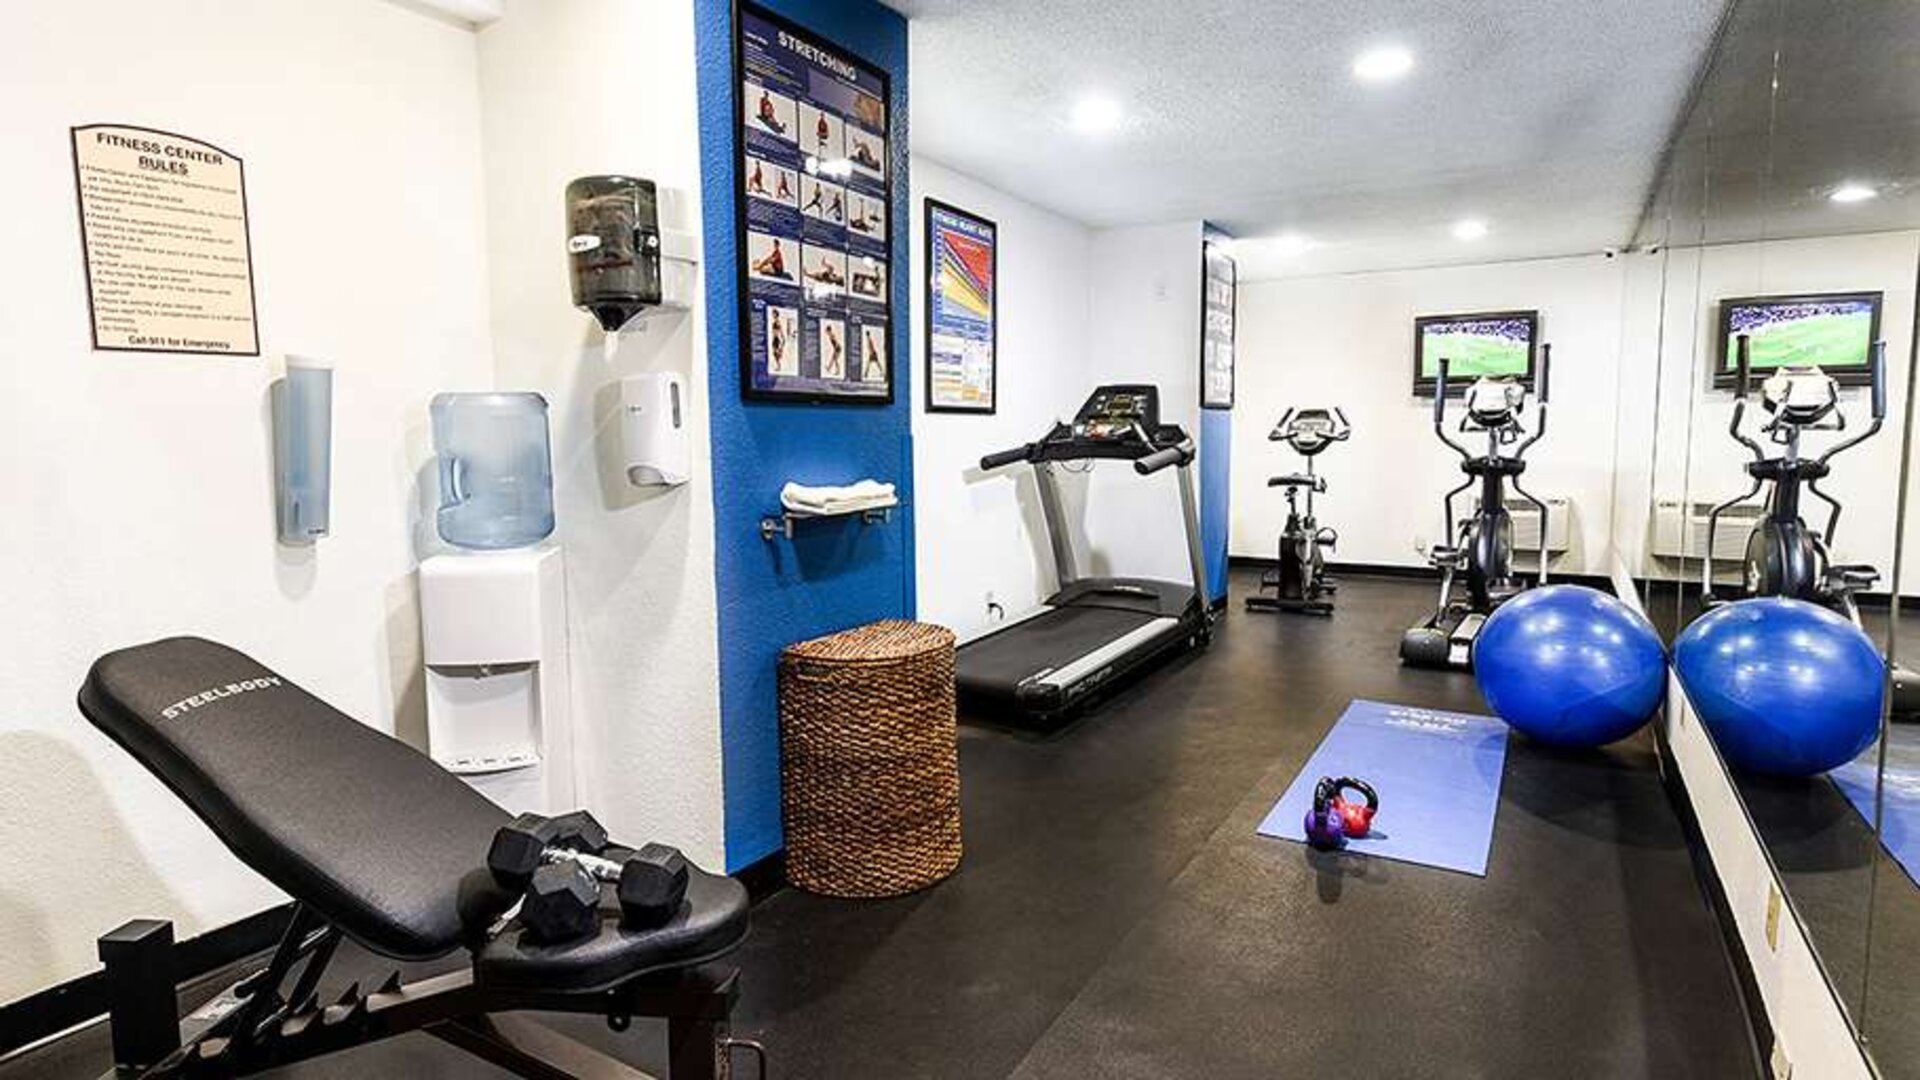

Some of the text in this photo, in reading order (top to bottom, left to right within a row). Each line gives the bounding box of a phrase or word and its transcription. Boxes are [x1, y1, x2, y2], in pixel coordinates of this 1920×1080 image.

[778, 30, 857, 81] STRETCHING
[97, 132, 223, 166] FITNESS CENTER
[138, 155, 189, 176] RULES
[183, 338, 230, 350] Emergency
[161, 676, 281, 719] STEELBODY
